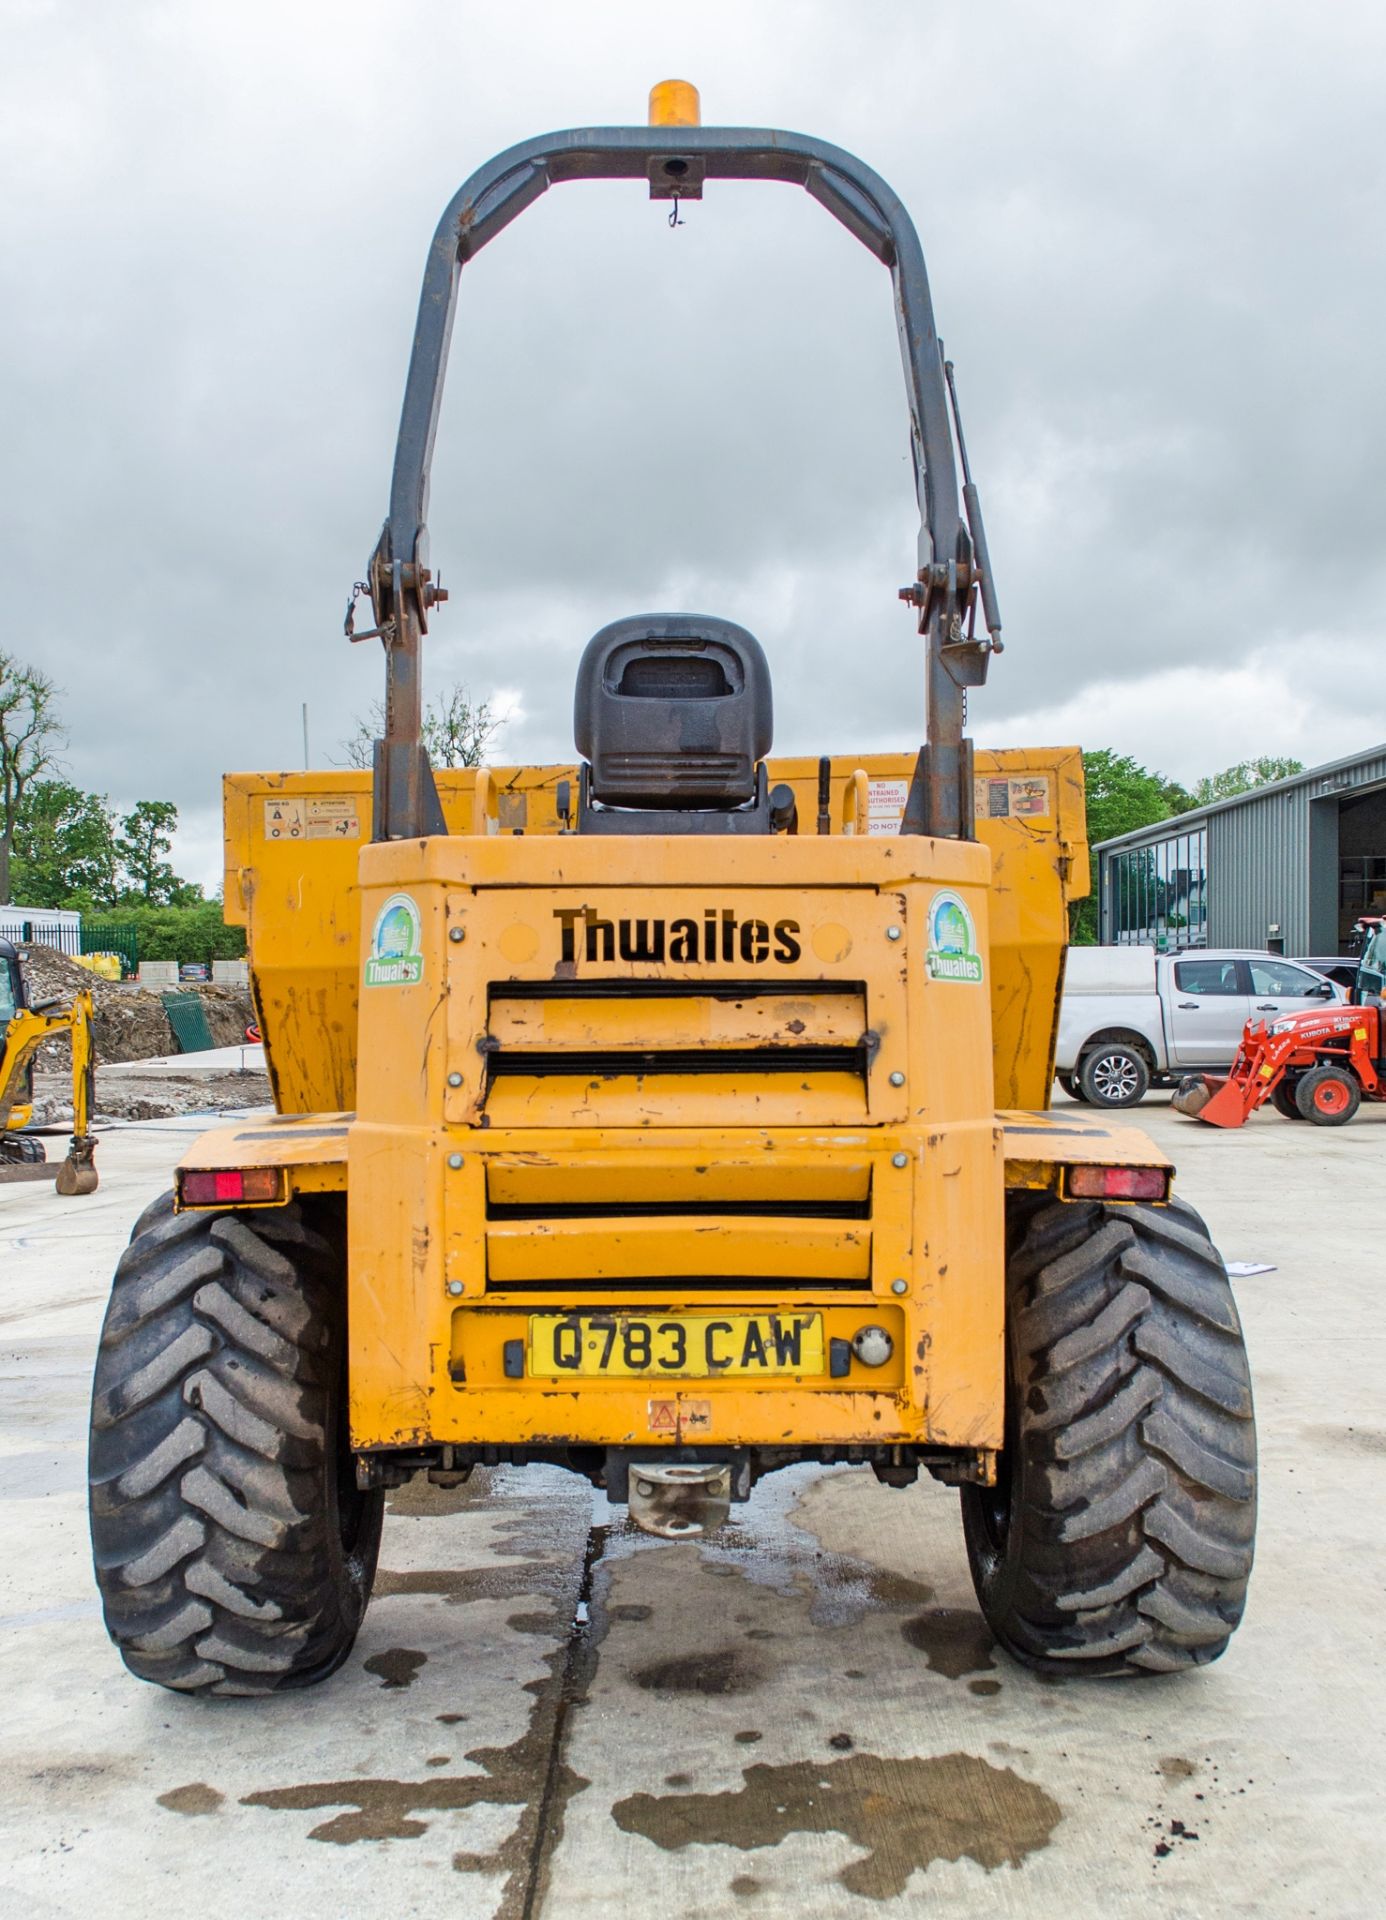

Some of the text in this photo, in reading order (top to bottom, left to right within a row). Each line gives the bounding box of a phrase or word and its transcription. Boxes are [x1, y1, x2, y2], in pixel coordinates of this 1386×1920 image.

[553, 908, 802, 964] Thwaites
[928, 955, 979, 978] Thwaites
[1301, 1028, 1331, 1039] KUBOTA
[553, 1319, 802, 1369] Q783 CAW
